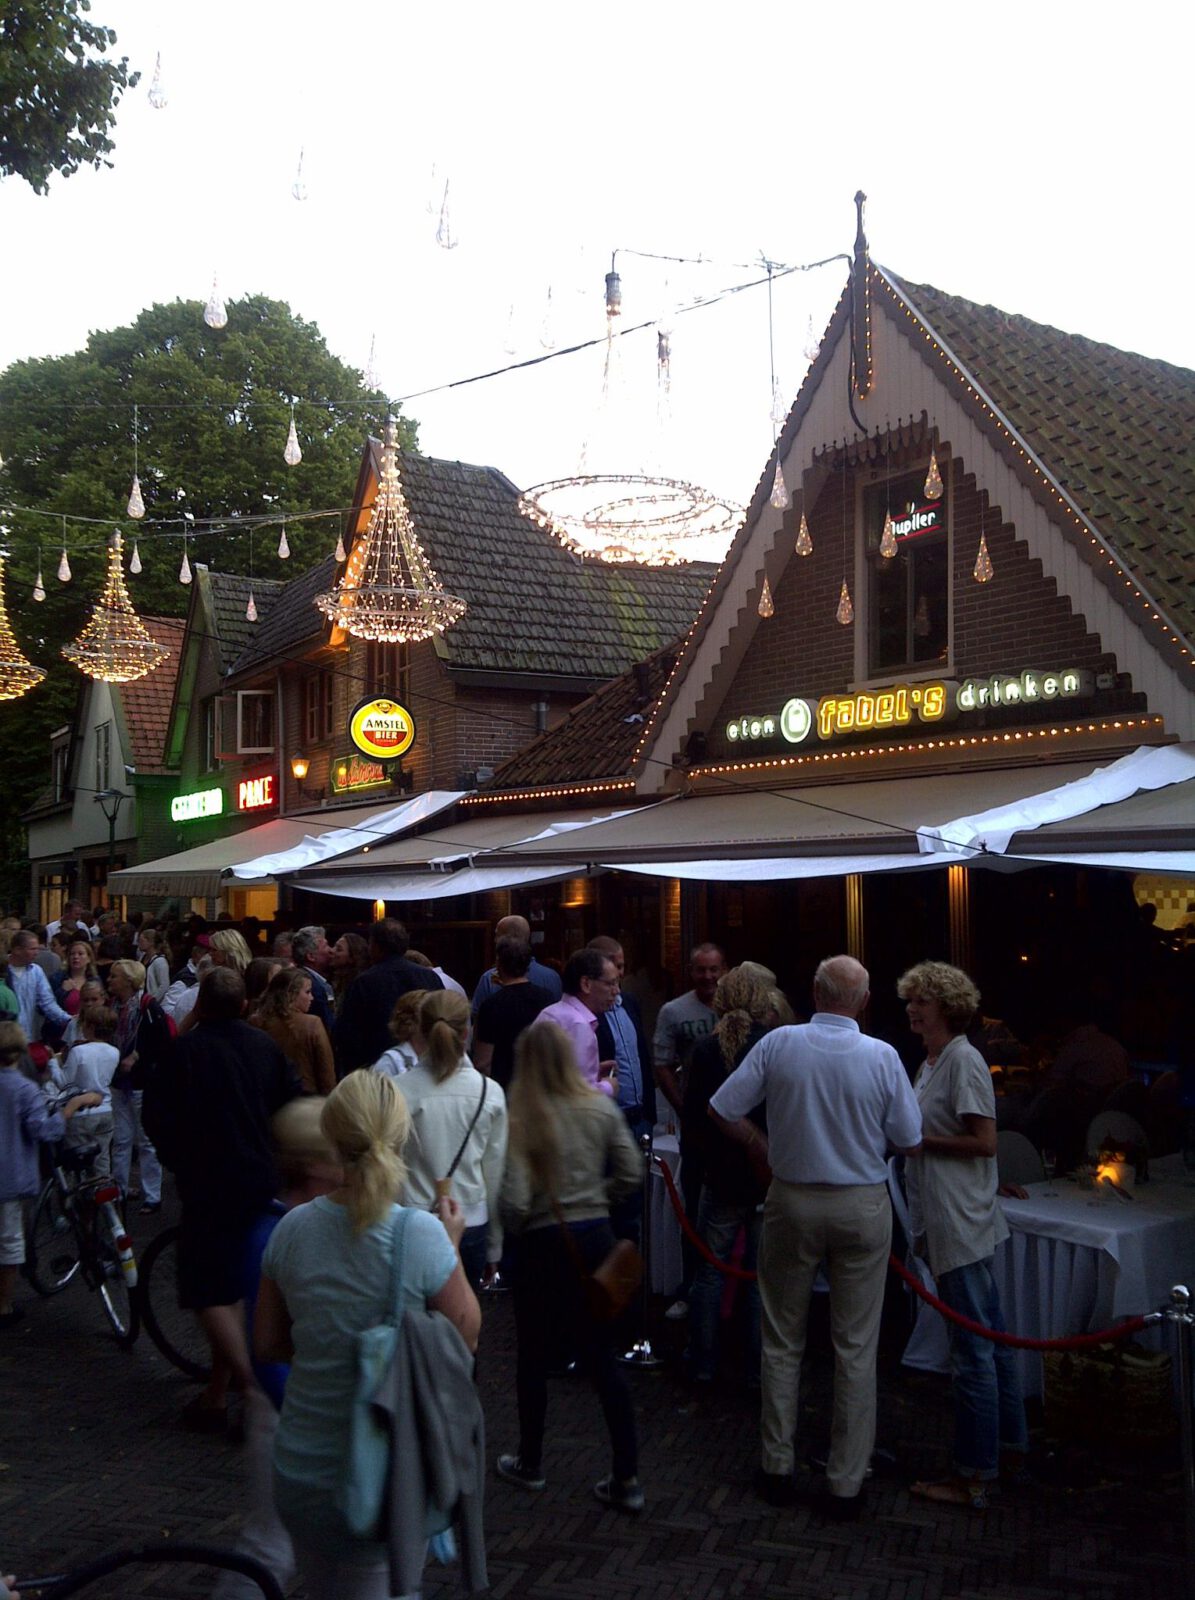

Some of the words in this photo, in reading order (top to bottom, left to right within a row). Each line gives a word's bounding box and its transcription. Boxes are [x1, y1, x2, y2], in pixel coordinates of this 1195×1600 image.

[820, 686, 944, 736] fabel's
[960, 674, 1077, 707] drinken
[366, 719, 405, 730] AMSTEL
[375, 731, 398, 739] BIER
